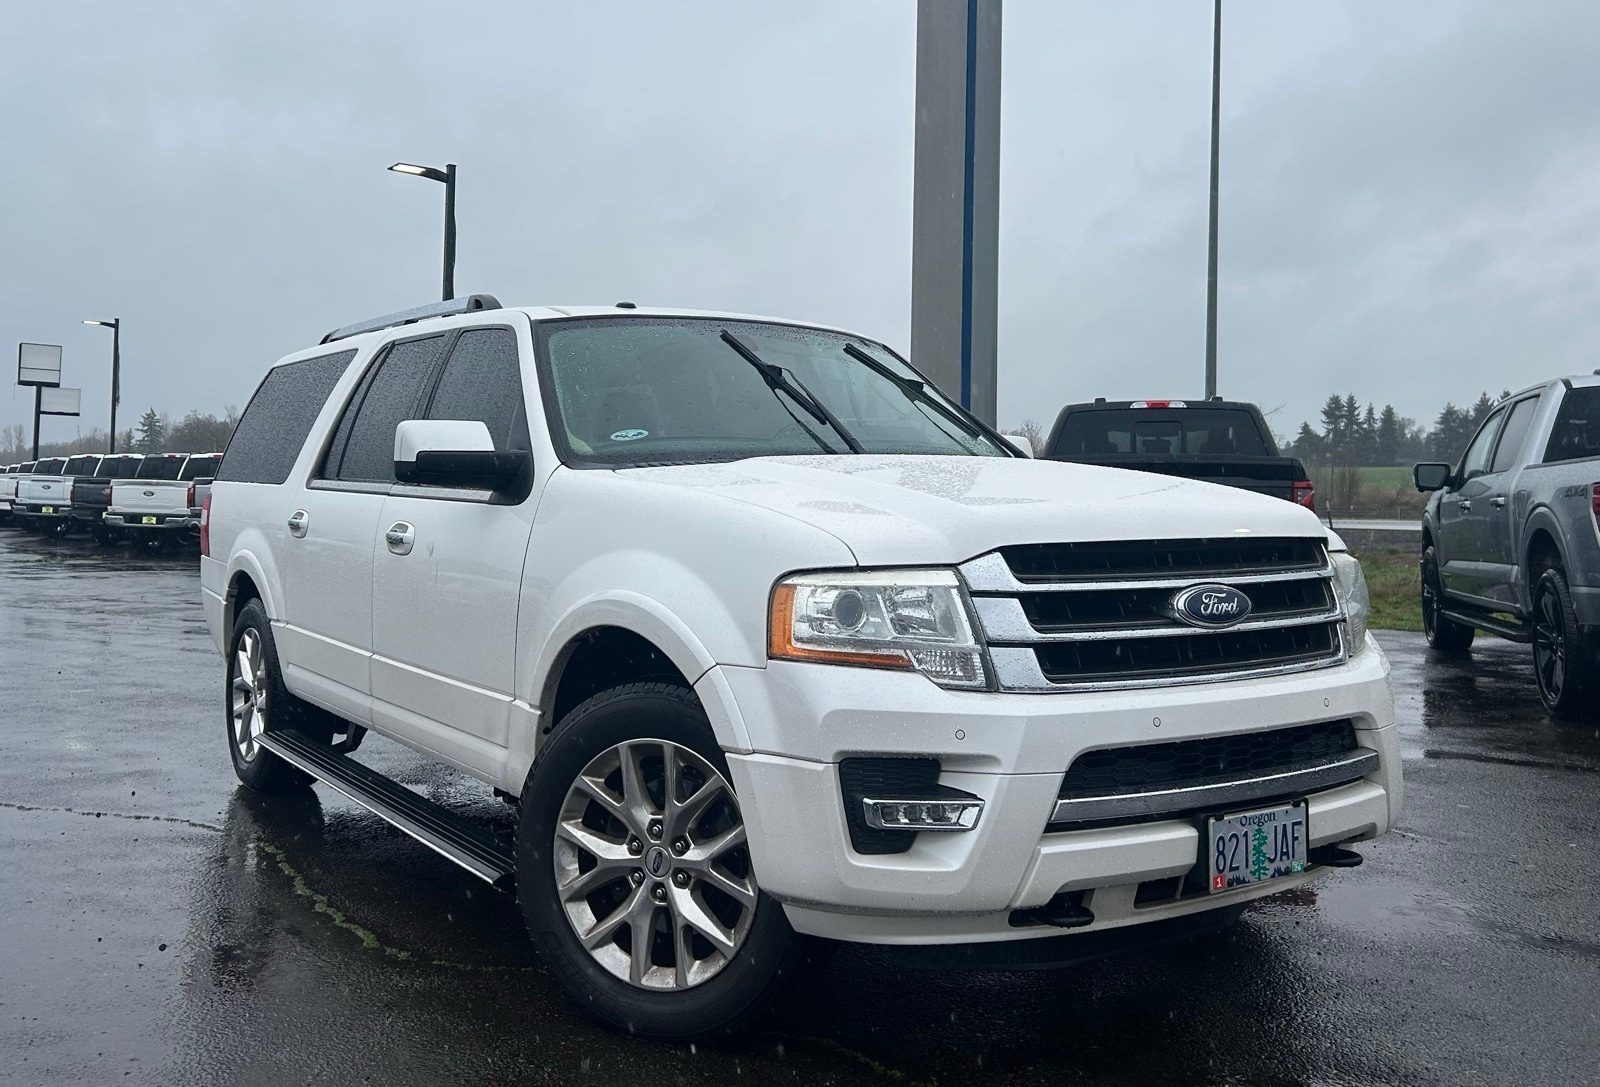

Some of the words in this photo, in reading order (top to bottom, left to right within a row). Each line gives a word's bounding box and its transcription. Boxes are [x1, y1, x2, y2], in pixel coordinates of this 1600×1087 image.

[1201, 592, 1239, 615] Ford
[1239, 812, 1276, 827] Oregon
[1215, 830, 1249, 875] 821
[1267, 820, 1303, 864] JAF
